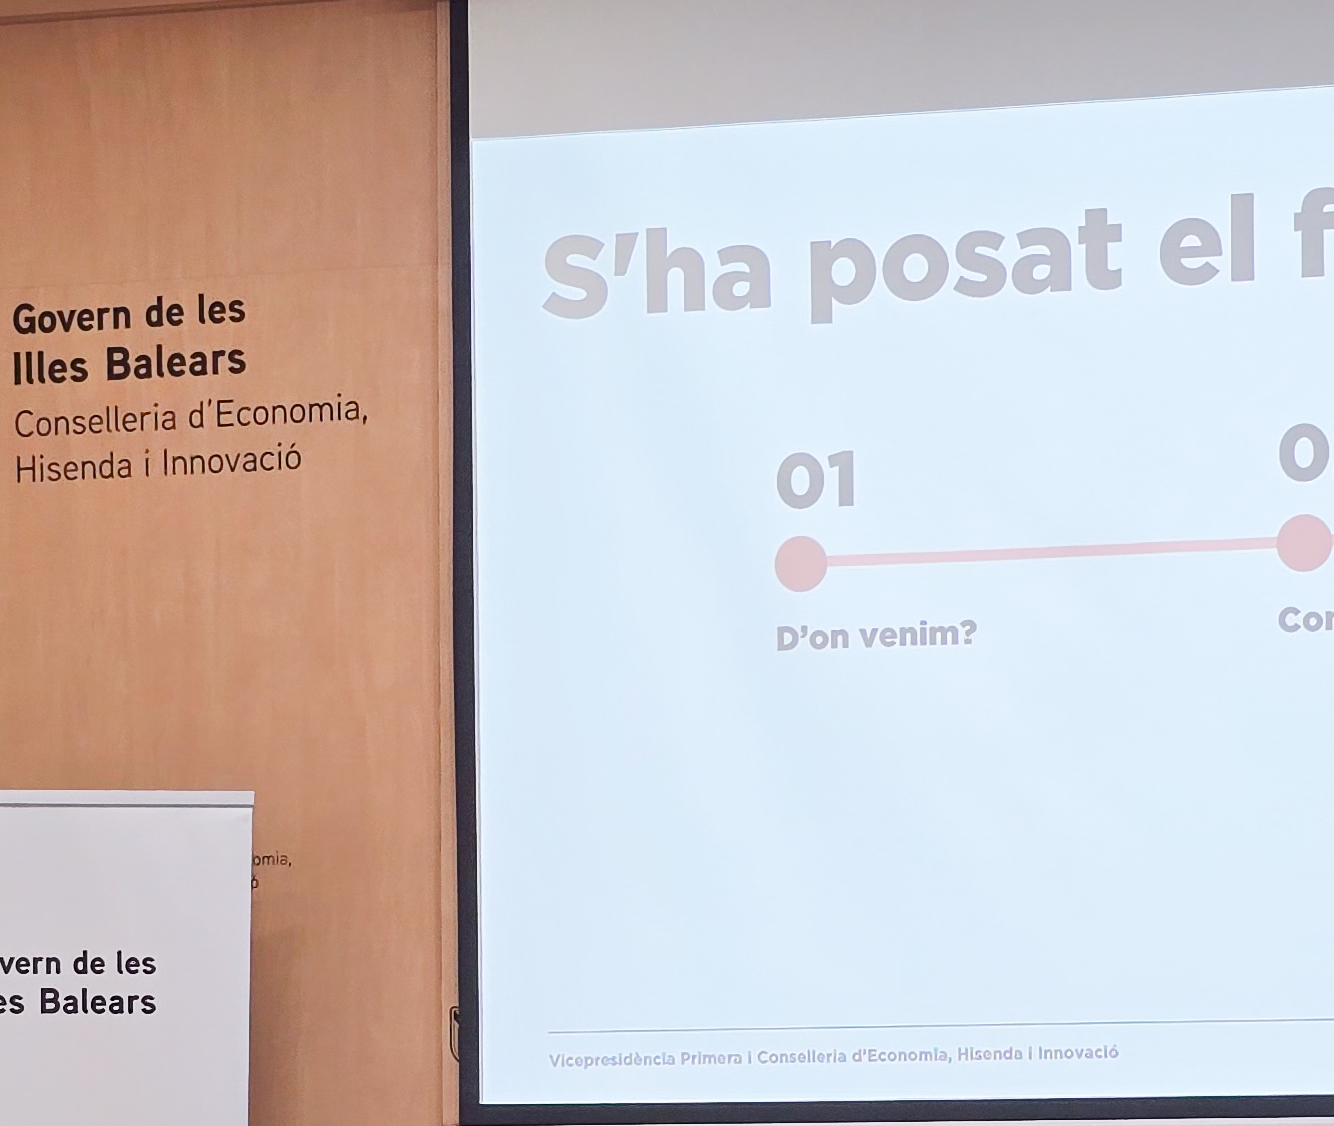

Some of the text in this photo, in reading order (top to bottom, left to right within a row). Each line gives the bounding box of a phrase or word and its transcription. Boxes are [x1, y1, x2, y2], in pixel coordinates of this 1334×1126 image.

[541, 226, 772, 320] S'ha
[809, 207, 1123, 325] posat
[1159, 192, 1255, 287] el
[12, 292, 246, 335] Govern de les
[13, 343, 247, 386] Illes Balears
[14, 392, 368, 438] Conselleria d'Economia,
[16, 441, 302, 484] Hisenda i Innovació
[776, 449, 855, 510] 01
[776, 619, 978, 652] D'on venim?
[72, 949, 106, 975] de
[116, 949, 157, 975] les
[40, 987, 157, 1015] Balears
[548, 1051, 676, 1070] Vicepresidència
[680, 1050, 743, 1066] Primera
[757, 1048, 847, 1065] Conselleria
[851, 1047, 953, 1064] d'Economia,
[957, 1045, 1024, 1062] Hisenda
[1038, 1043, 1120, 1060] Innovació
